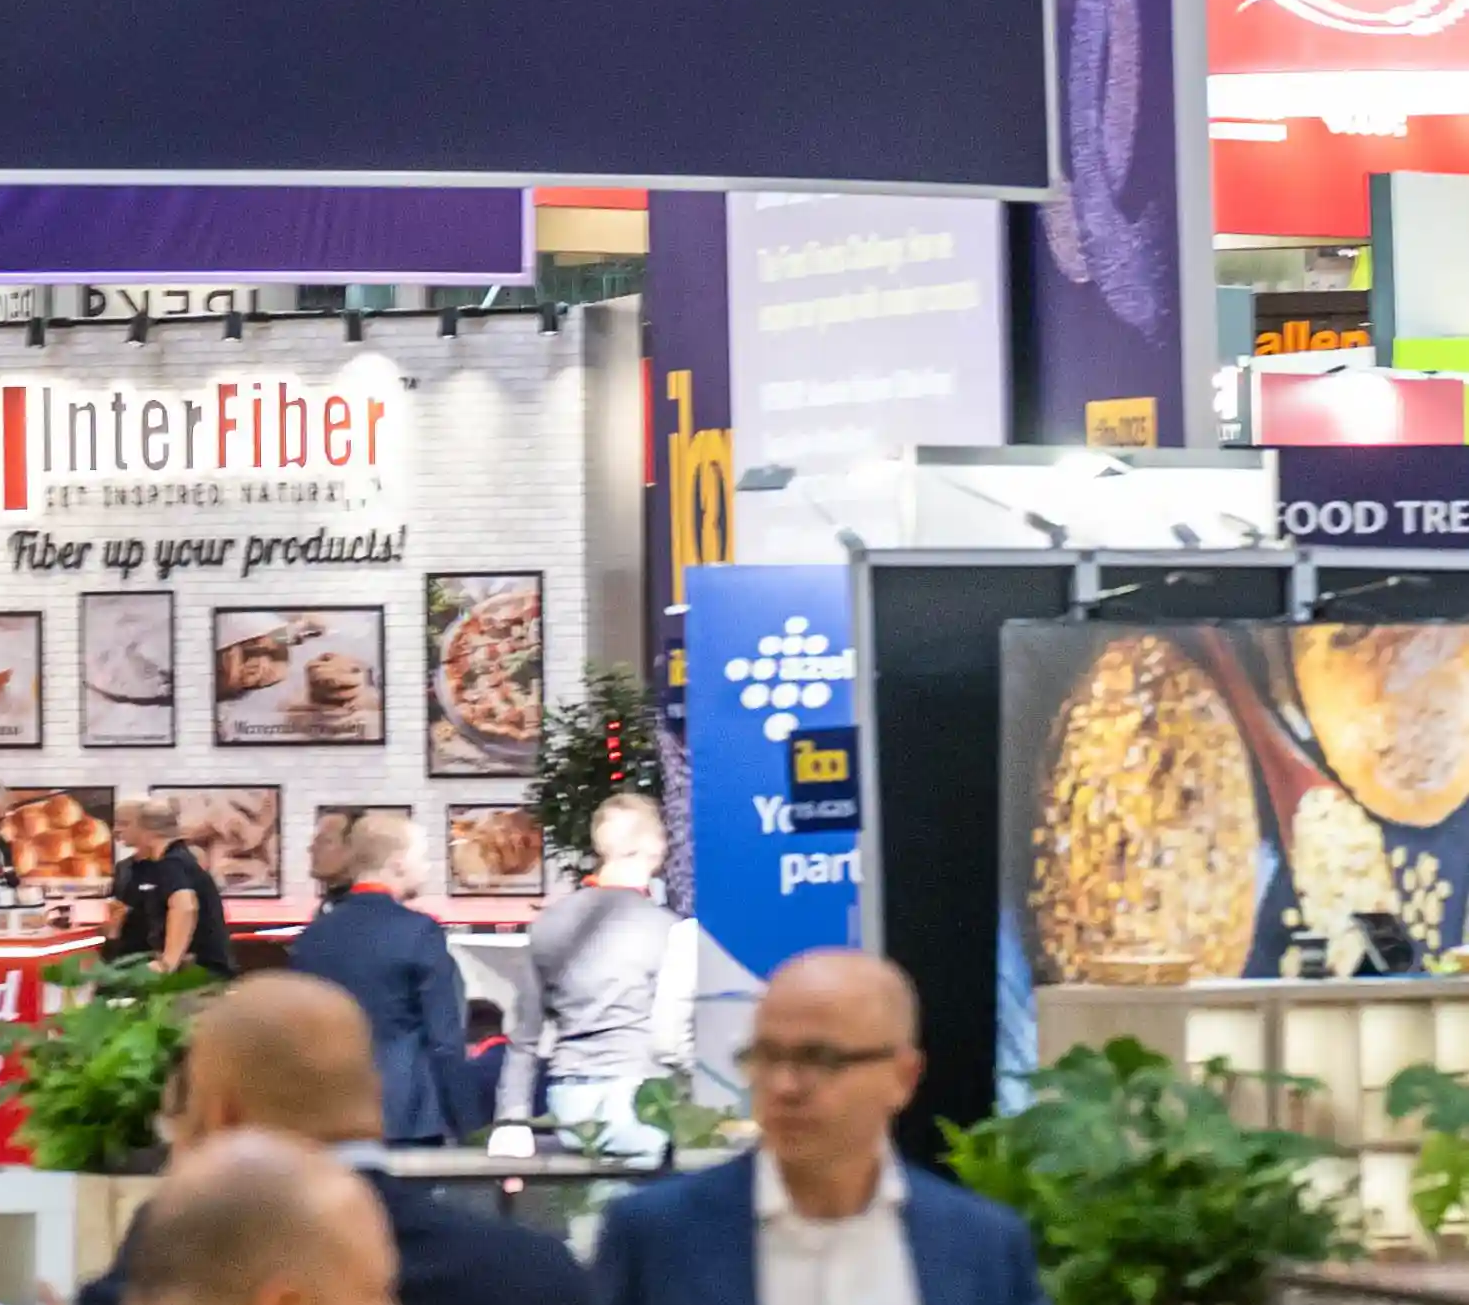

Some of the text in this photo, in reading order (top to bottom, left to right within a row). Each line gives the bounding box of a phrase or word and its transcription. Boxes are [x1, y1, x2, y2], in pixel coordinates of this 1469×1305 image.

[42, 382, 386, 471] InterFiber
[1395, 500, 1469, 535] TRE
[7, 523, 408, 580] Fiber up your products!
